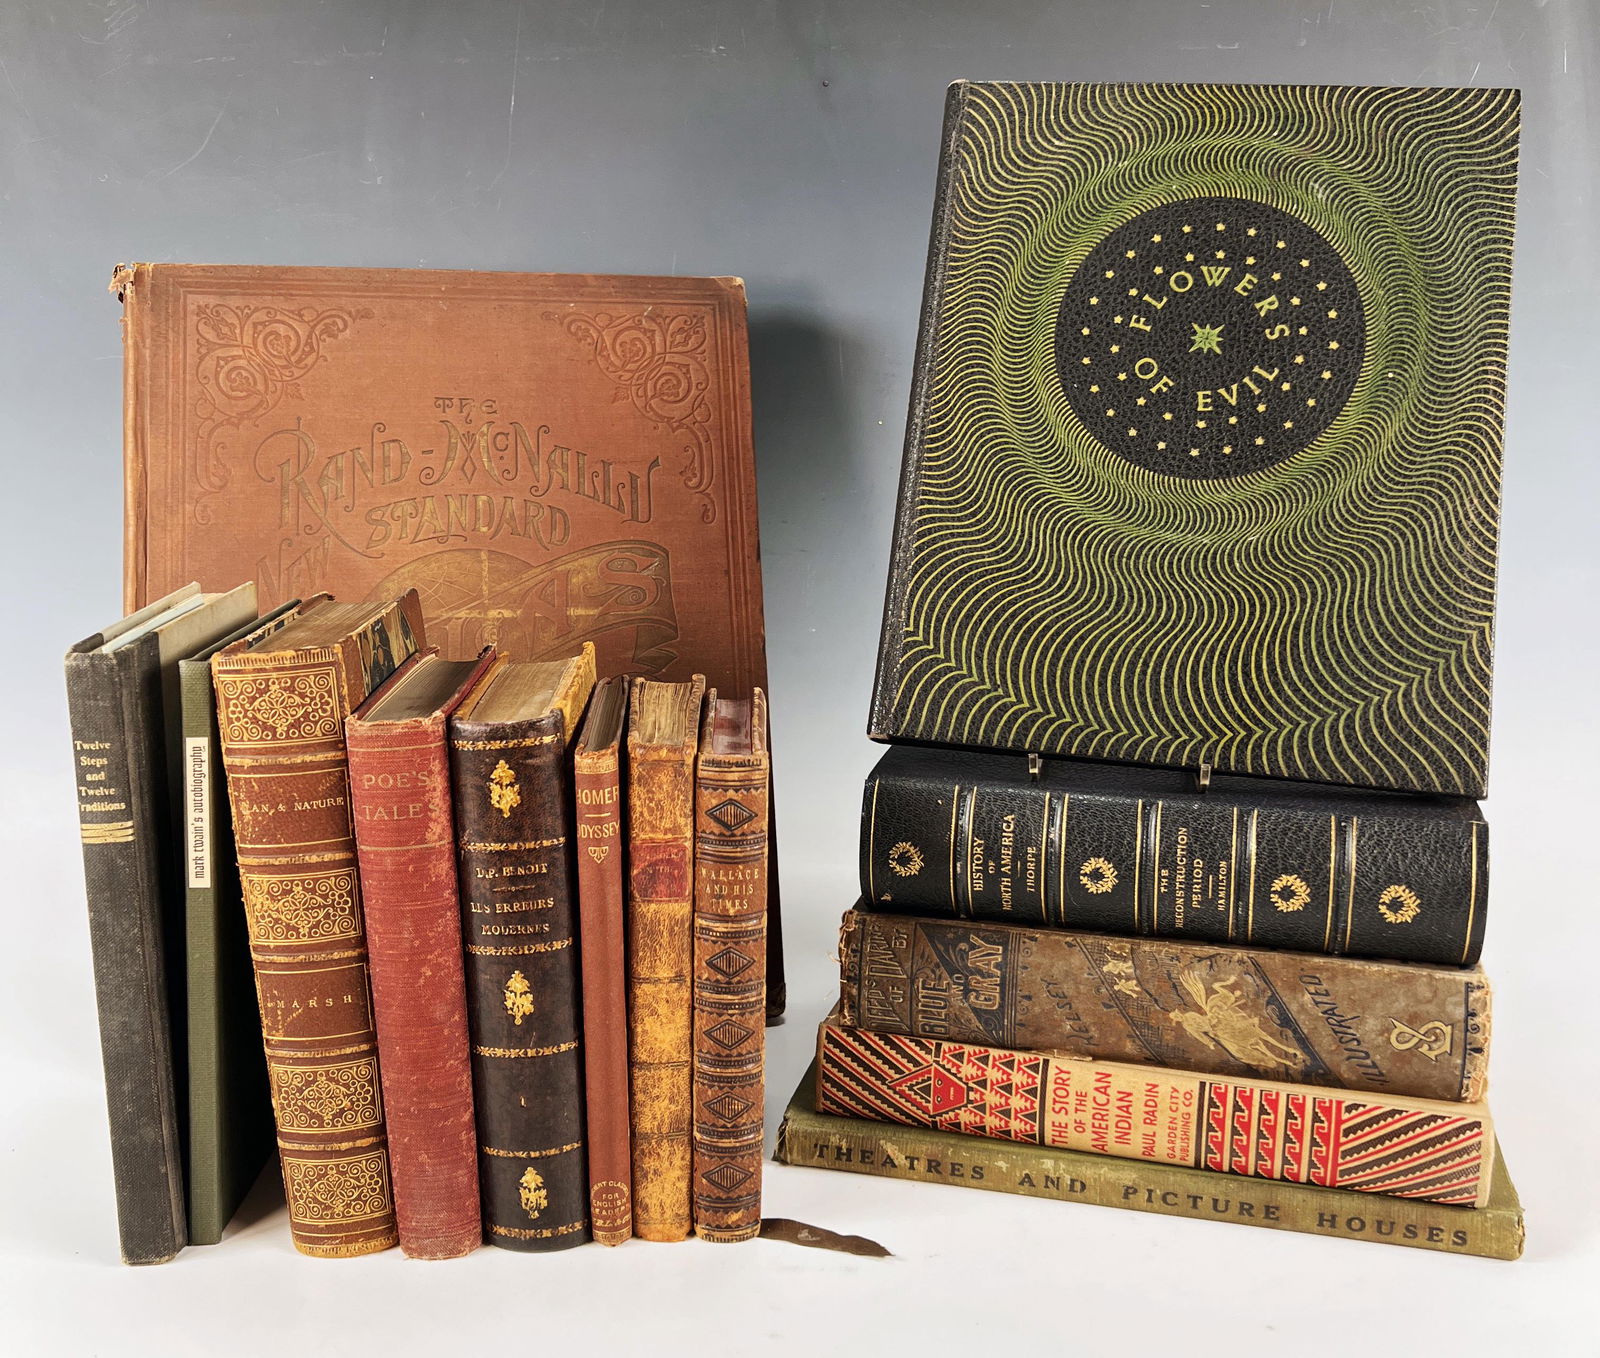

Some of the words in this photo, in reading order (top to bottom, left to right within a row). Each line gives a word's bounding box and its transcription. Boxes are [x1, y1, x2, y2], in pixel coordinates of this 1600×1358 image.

[1129, 265, 1291, 340] FLOWERS
[1134, 357, 1175, 395] OF
[1196, 365, 1280, 412] EVIL
[433, 397, 499, 425] THE
[364, 493, 571, 551] STANDARD
[74, 741, 112, 751] Twelve
[80, 756, 108, 767] Steps
[86, 772, 106, 781] and
[189, 745, 207, 813] autobiography
[362, 770, 431, 790] POE'S
[78, 787, 116, 797] Twelve
[277, 803, 287, 812] &
[294, 797, 344, 811] NATURE
[361, 802, 440, 821] TALES
[191, 817, 204, 853] twain's
[1001, 814, 1015, 874] AMERICA
[193, 855, 205, 879] mark
[973, 837, 985, 891] HISTORY
[988, 860, 996, 874] OF
[1026, 846, 1036, 892] THORPE
[1175, 827, 1188, 928] RECONSTRUCTION
[705, 883, 728, 895] AND
[733, 883, 754, 895] HIS
[1001, 878, 1012, 911] NORTH
[1160, 869, 1169, 893] THE
[1192, 858, 1203, 909] PERIOD
[1217, 861, 1227, 911] HAMILTON
[495, 897, 555, 914] ERREURS
[891, 928, 907, 949] BY
[968, 934, 1002, 1010] GRAY
[277, 994, 353, 1009] MARSH
[889, 986, 904, 1003] OF
[951, 973, 965, 1002] AND
[918, 977, 950, 1036] BLUE
[1052, 1065, 1071, 1116] STORY
[1075, 1090, 1088, 1114] THE
[1143, 1082, 1159, 1126] RADIN
[1169, 1086, 1180, 1113] CITY
[1182, 1089, 1194, 1109] CO.
[1091, 1071, 1112, 1153] AMERICAN
[1115, 1090, 1133, 1146] INDIAN
[1051, 1121, 1069, 1145] THE
[1074, 1120, 1087, 1134] OF
[1167, 1116, 1178, 1159] GARDEN
[1179, 1112, 1191, 1162] PUBLISHING
[1142, 1131, 1156, 1158] PAUL
[602, 1192, 619, 1200] FOR
[813, 1143, 985, 1180] THEATRES
[1018, 1172, 1087, 1194] AND
[1121, 1185, 1281, 1222] PICTURE
[1316, 1212, 1467, 1247] HOUSES
